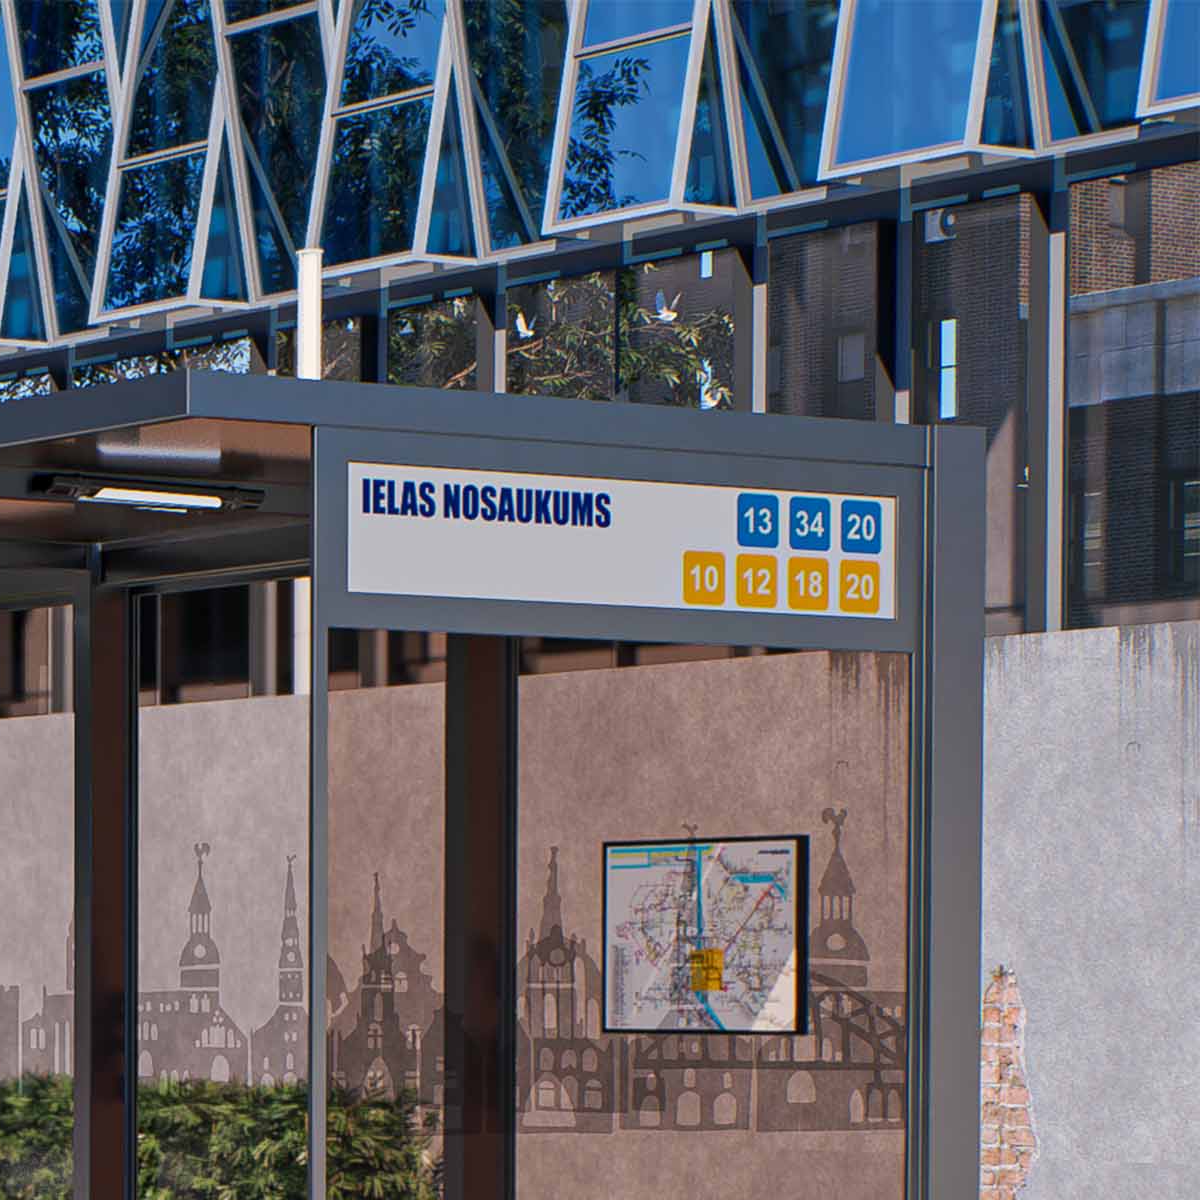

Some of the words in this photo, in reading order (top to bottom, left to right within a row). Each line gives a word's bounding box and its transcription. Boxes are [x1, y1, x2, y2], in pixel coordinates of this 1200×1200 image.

[363, 478, 436, 517] IELAS
[444, 484, 611, 528] NOSAUKUMS
[745, 508, 771, 534] 13
[796, 511, 824, 536] 34
[848, 514, 875, 540] 20
[691, 566, 717, 592] 10
[743, 569, 770, 595] 12
[795, 572, 821, 597] 18
[846, 574, 873, 600] 20
